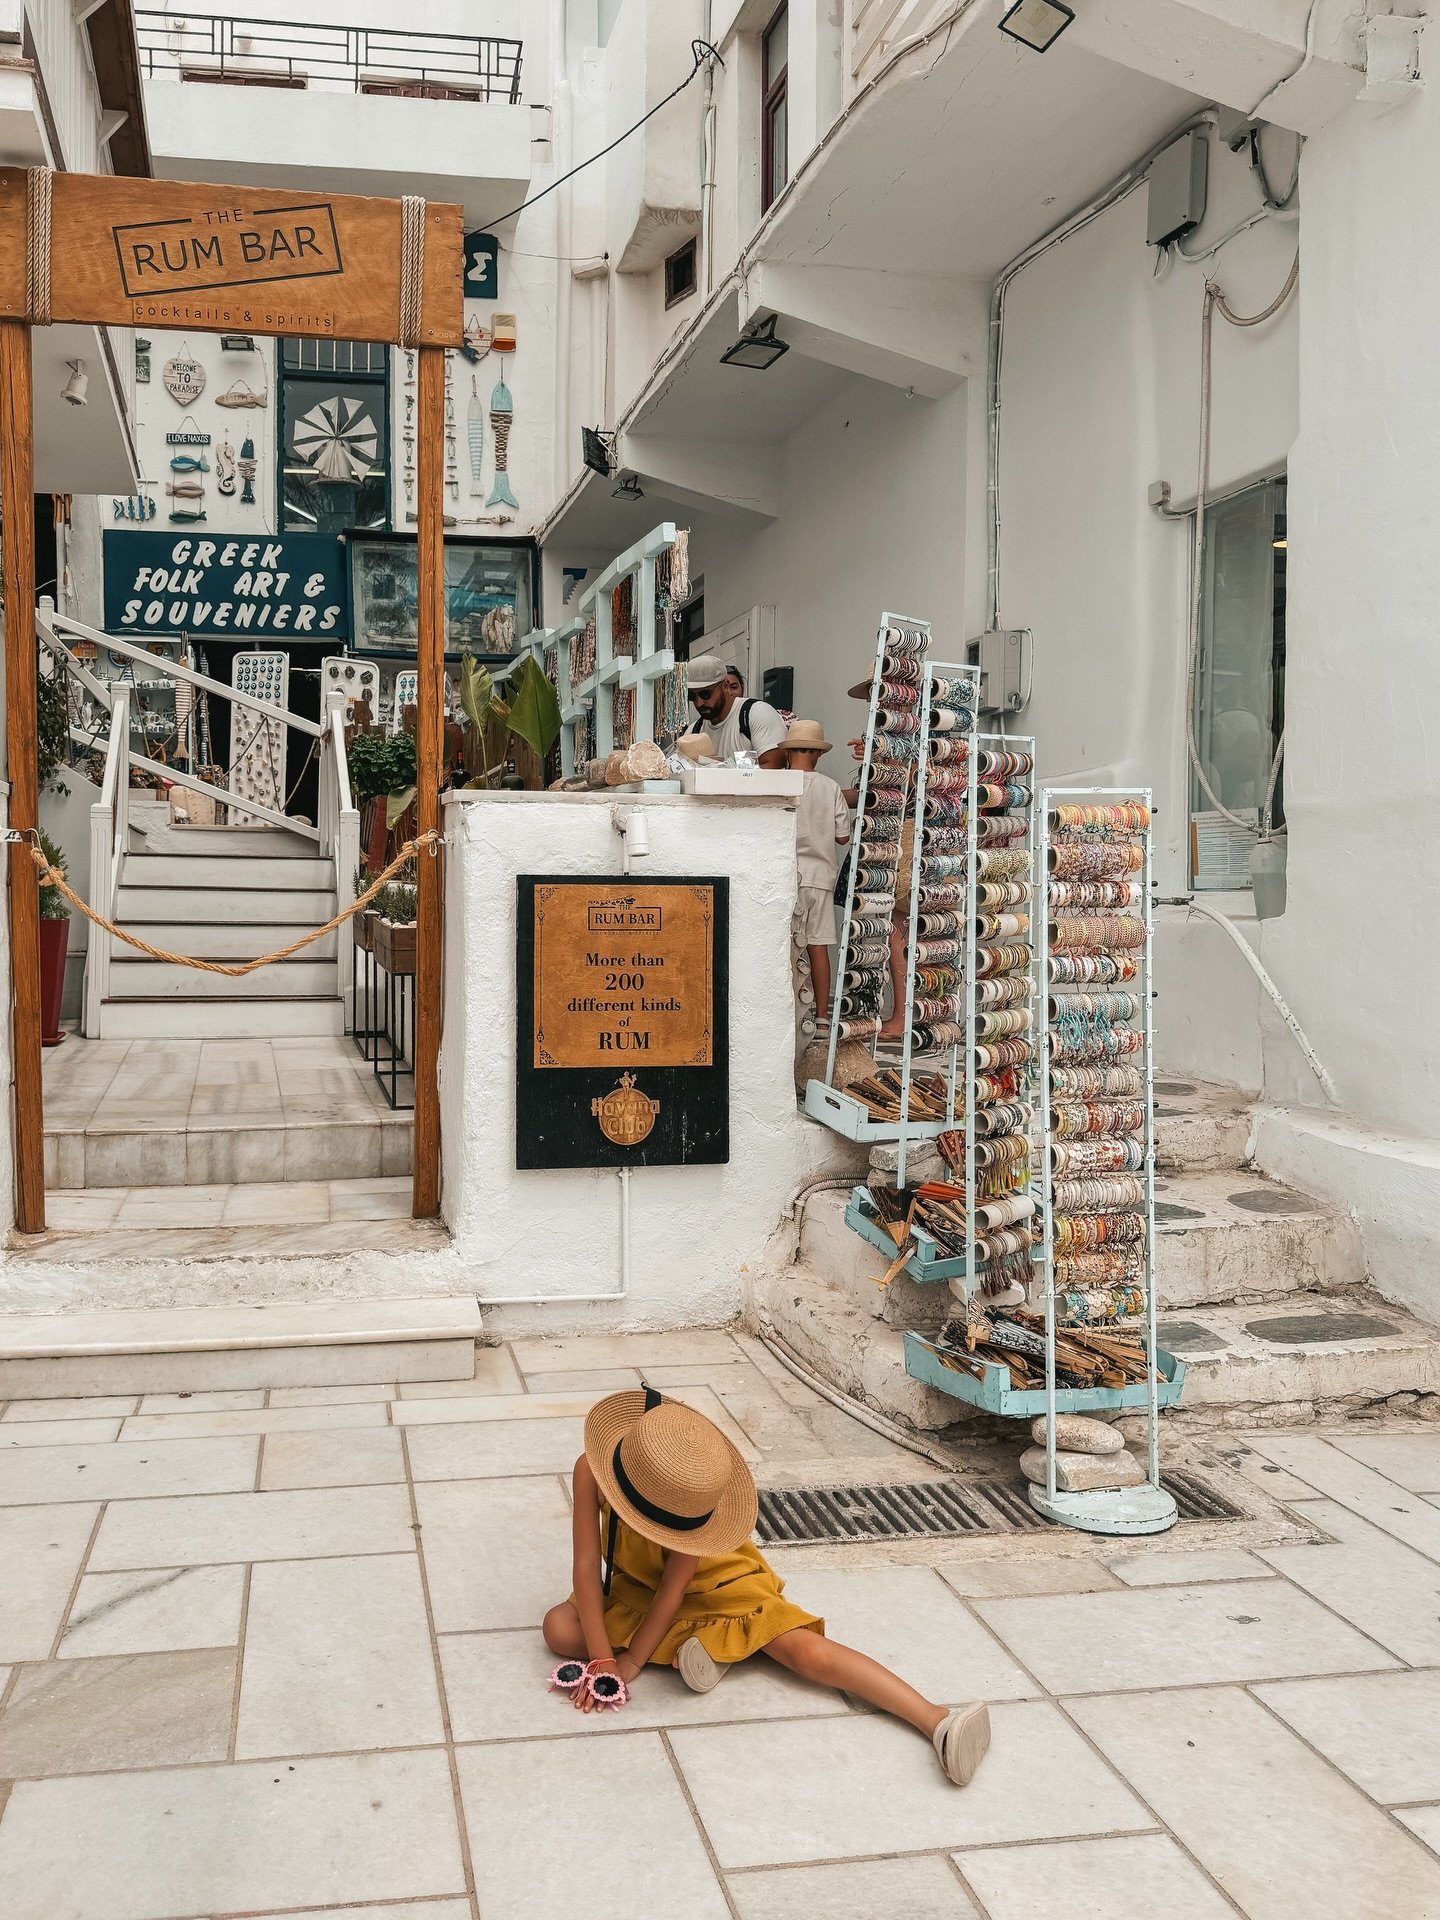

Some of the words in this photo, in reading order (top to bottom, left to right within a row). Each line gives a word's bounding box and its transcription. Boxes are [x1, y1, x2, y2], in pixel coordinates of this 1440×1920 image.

[203, 208, 244, 225] THE
[133, 235, 224, 276] RUM
[239, 226, 323, 264] BAR
[136, 305, 230, 321] cocktails
[243, 311, 252, 322] &
[265, 313, 331, 327] spirits
[172, 363, 197, 373] WELCOME
[177, 372, 191, 383] TO
[169, 384, 199, 394] PARADISE
[167, 434, 172, 442] I
[172, 434, 187, 443] LOVE
[187, 435, 209, 443] NAXOS
[172, 540, 283, 569] GREEK
[133, 567, 204, 594] FOLK
[233, 571, 291, 598] ART
[303, 573, 326, 598] &
[121, 599, 341, 631] SOUVENIERS
[595, 913, 625, 924] RUM
[629, 913, 655, 924] BAR
[585, 953, 625, 967] More
[631, 953, 664, 967] than
[605, 973, 644, 991] 200
[567, 998, 634, 1012] different
[641, 998, 681, 1012] kinds
[619, 1016, 631, 1027] of
[598, 1031, 651, 1050] RUM
[591, 1097, 660, 1117] Havana
[606, 1116, 646, 1135] Club
